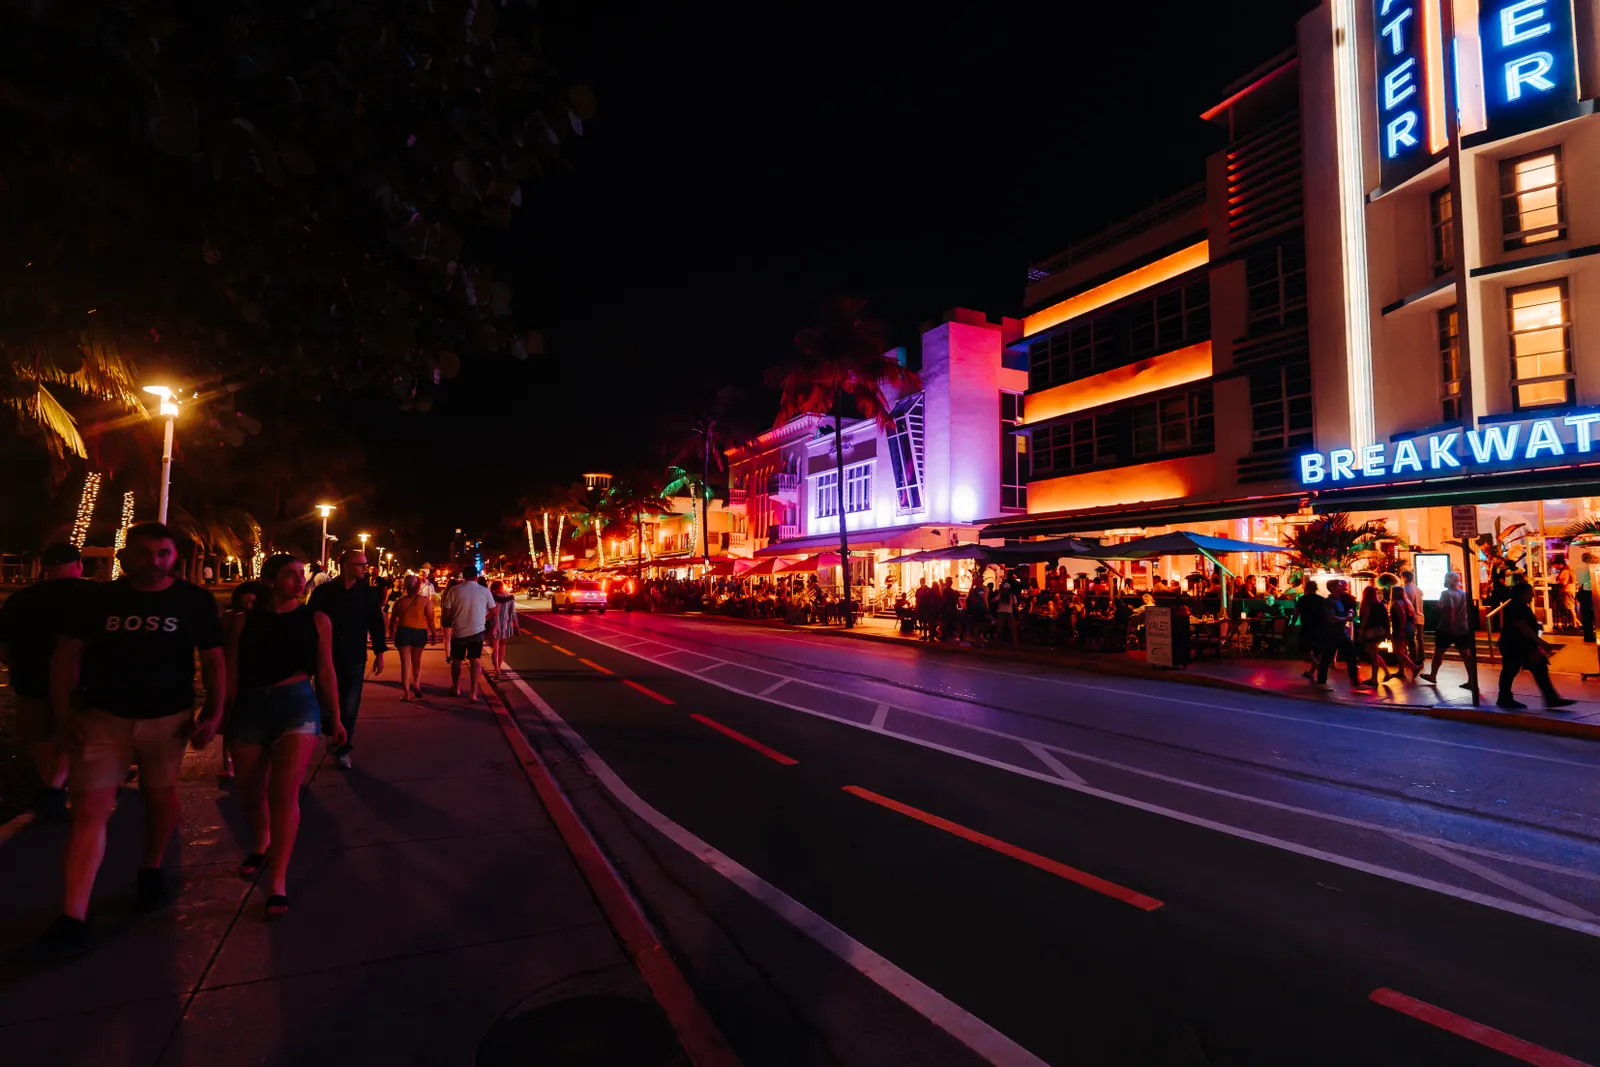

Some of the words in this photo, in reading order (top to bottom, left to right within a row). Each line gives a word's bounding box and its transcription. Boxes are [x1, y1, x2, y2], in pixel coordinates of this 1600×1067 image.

[1499, 0, 1556, 102] ER
[1300, 412, 1600, 484] BREAKWAT
[104, 615, 180, 632] BOSS
[1147, 621, 1169, 631] VALET
